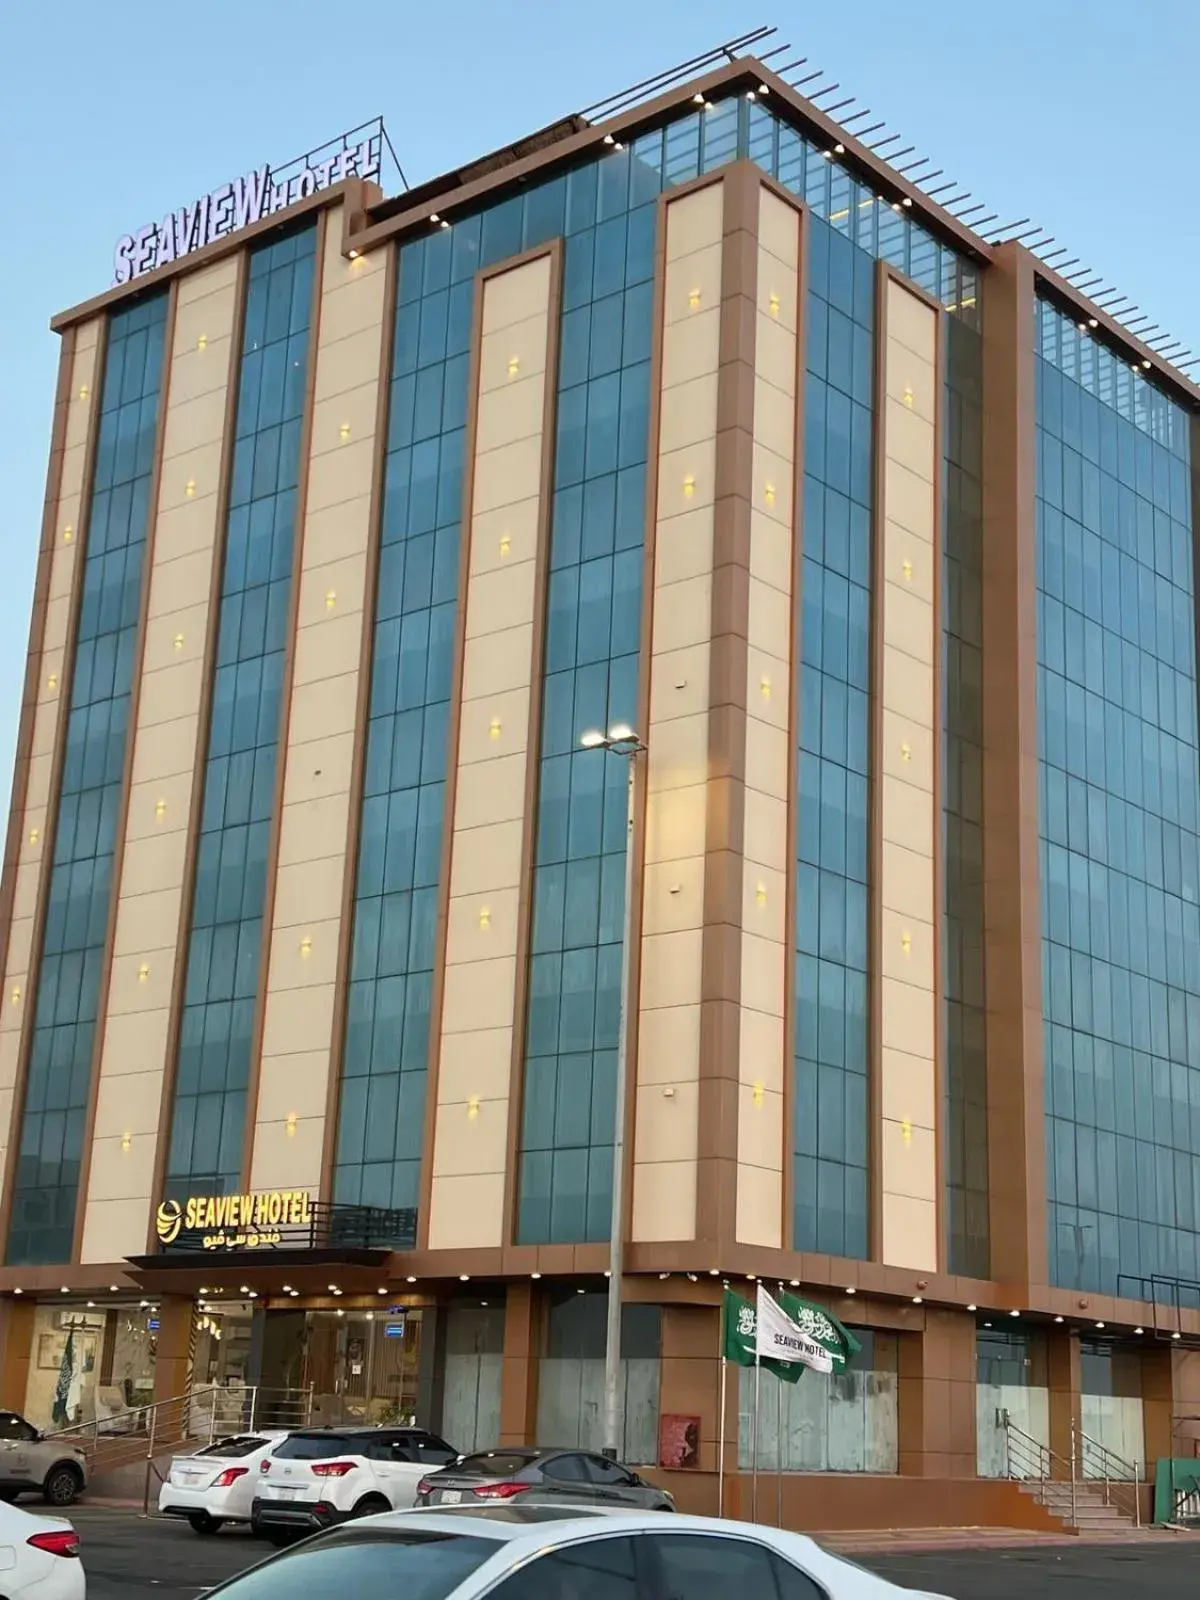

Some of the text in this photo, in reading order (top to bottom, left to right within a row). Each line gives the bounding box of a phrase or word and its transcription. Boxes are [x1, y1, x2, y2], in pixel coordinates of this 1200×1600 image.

[111, 138, 380, 286] SEAVIEW HOTEL
[185, 1192, 312, 1229] SEAVIEW HOTEL
[247, 1228, 282, 1247] فندق
[774, 1333, 826, 1358] SEAVIEW HOTEL
